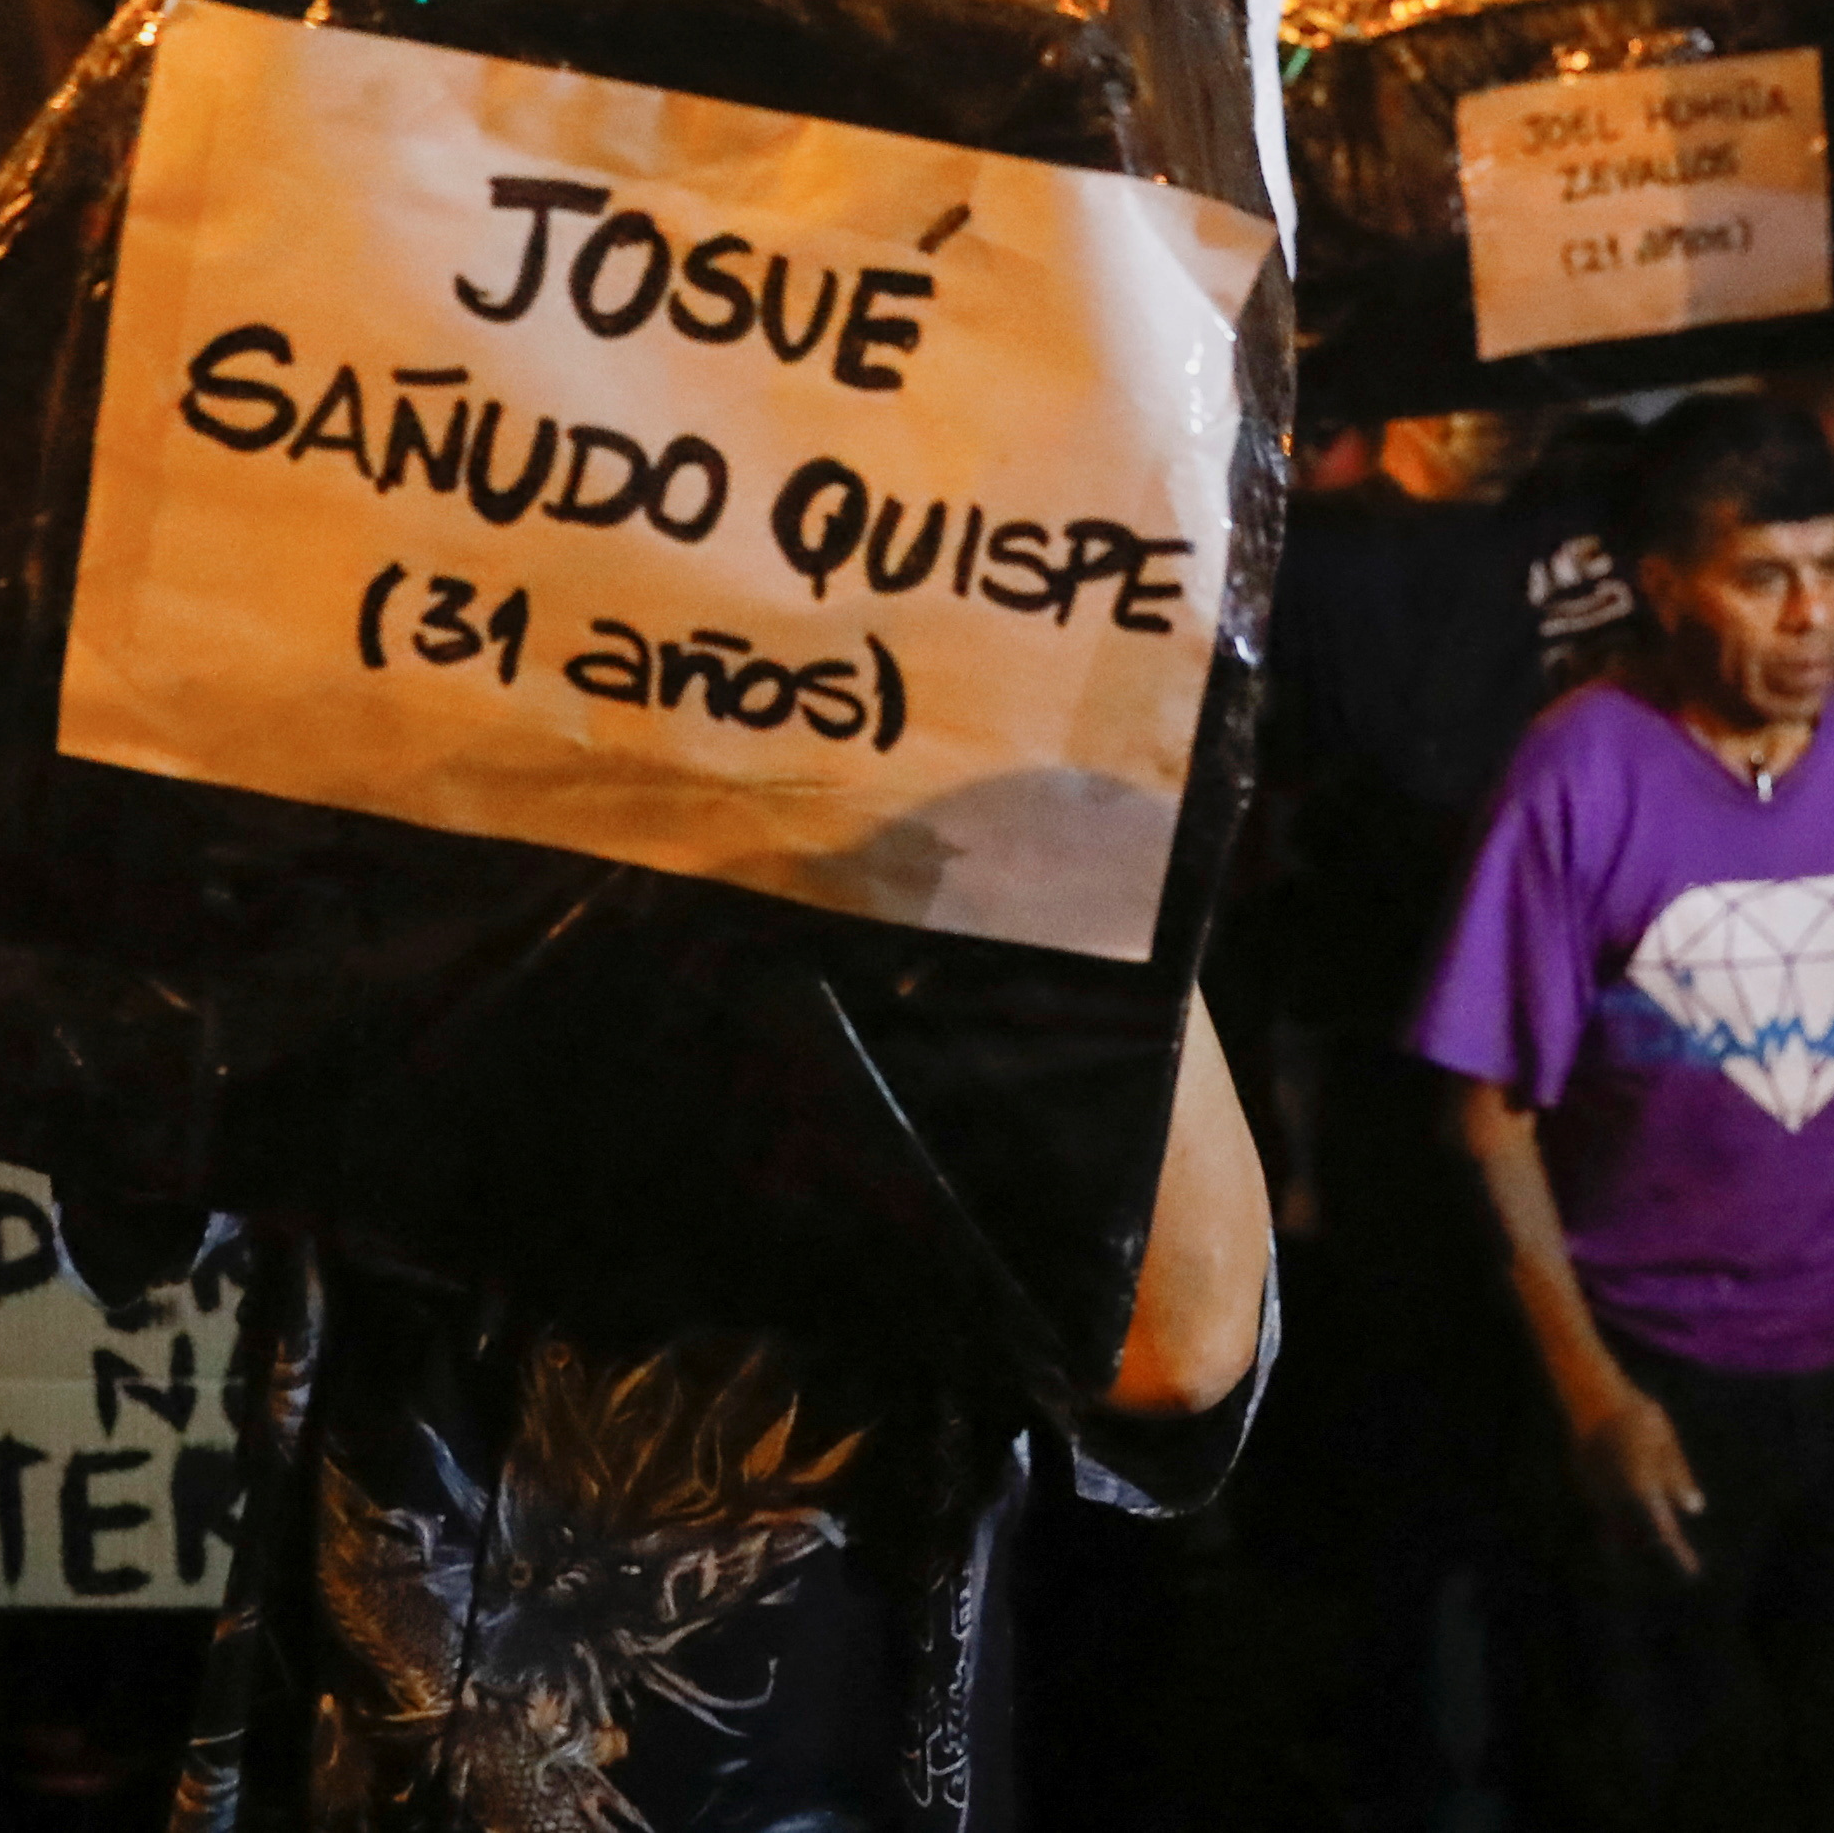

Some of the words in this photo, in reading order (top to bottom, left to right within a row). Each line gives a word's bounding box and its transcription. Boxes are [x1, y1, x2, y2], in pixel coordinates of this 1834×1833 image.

[456, 175, 969, 390] JOSUÉ
[179, 325, 727, 543] SAÑUDO
[771, 457, 1190, 634] QUISPE
[359, 563, 531, 685] (31
[565, 618, 907, 752] años)
